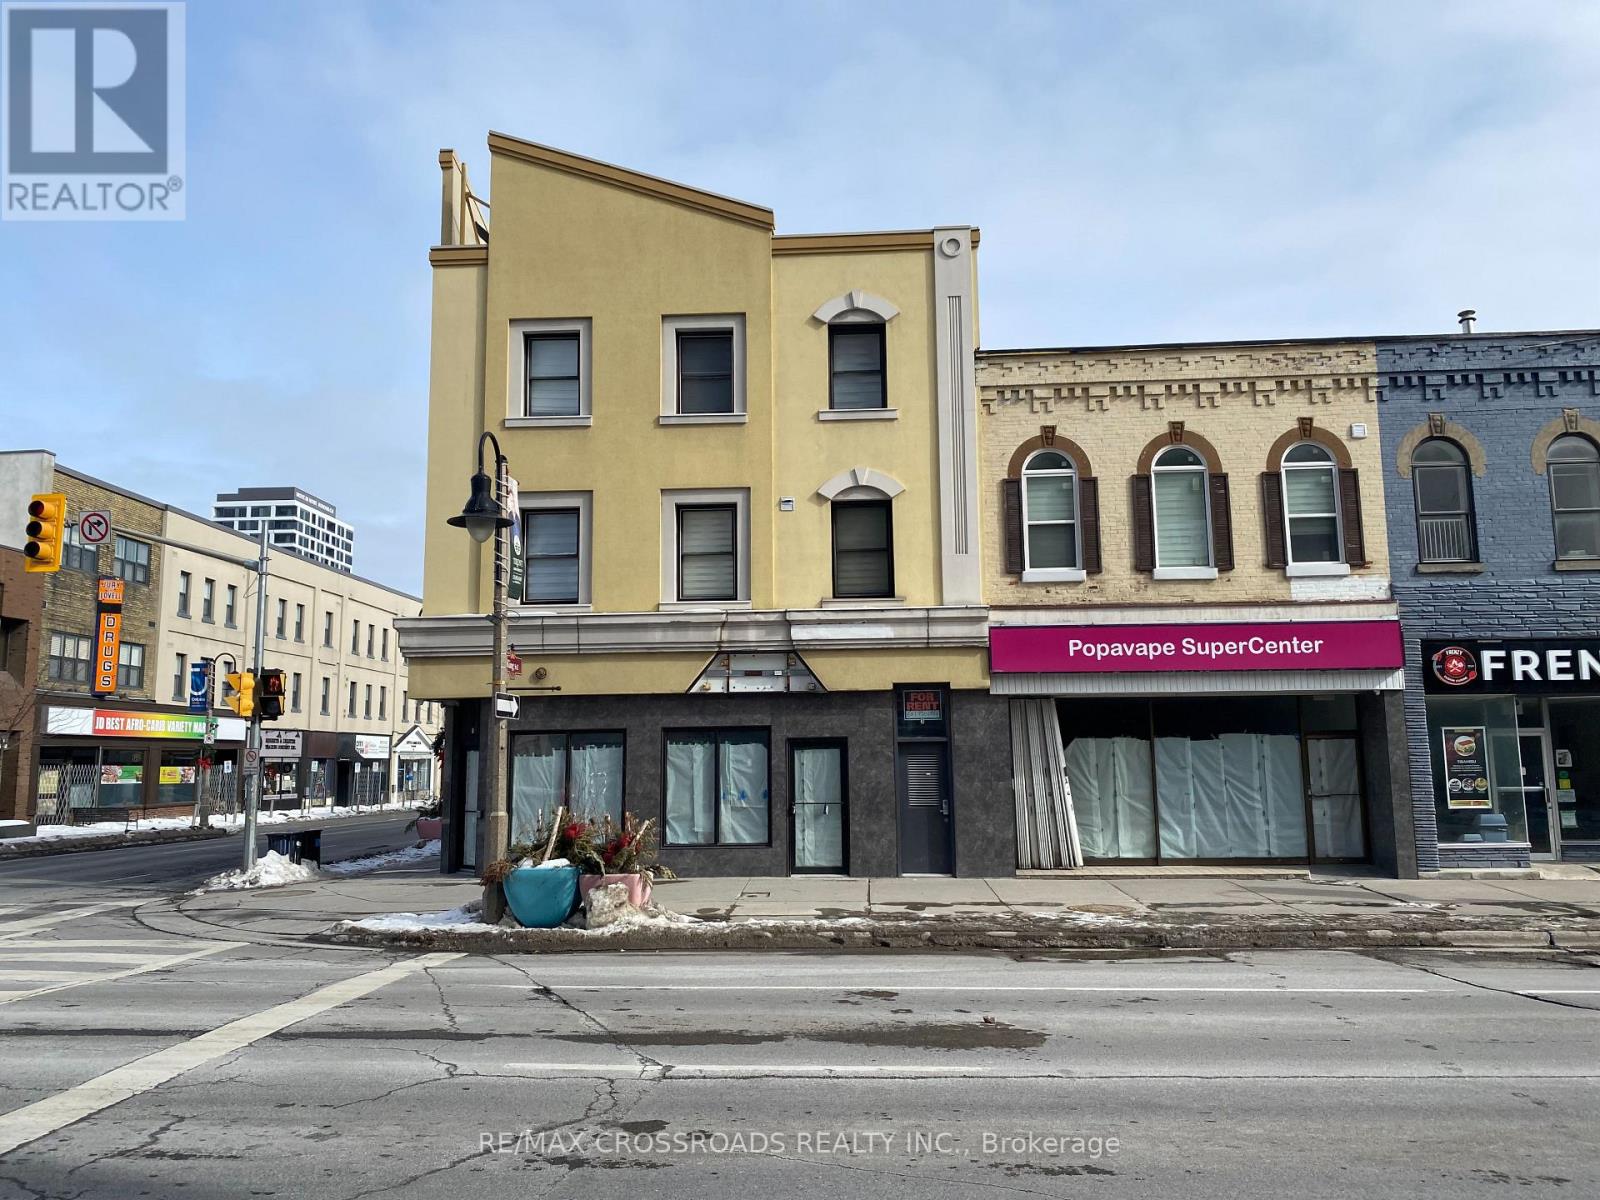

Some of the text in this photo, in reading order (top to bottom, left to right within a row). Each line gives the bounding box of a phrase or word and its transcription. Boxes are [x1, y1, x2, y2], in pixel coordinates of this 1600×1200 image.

[101, 615, 116, 687] DRUGS
[1068, 636, 1324, 660] Popavape SuperCenter
[1480, 650, 1600, 681] FREN
[906, 701, 939, 711] RENT
[911, 692, 934, 702] FOR
[106, 717, 125, 730] BEST
[126, 718, 166, 732] AFRO-CARIB
[167, 720, 192, 733] VARIETY
